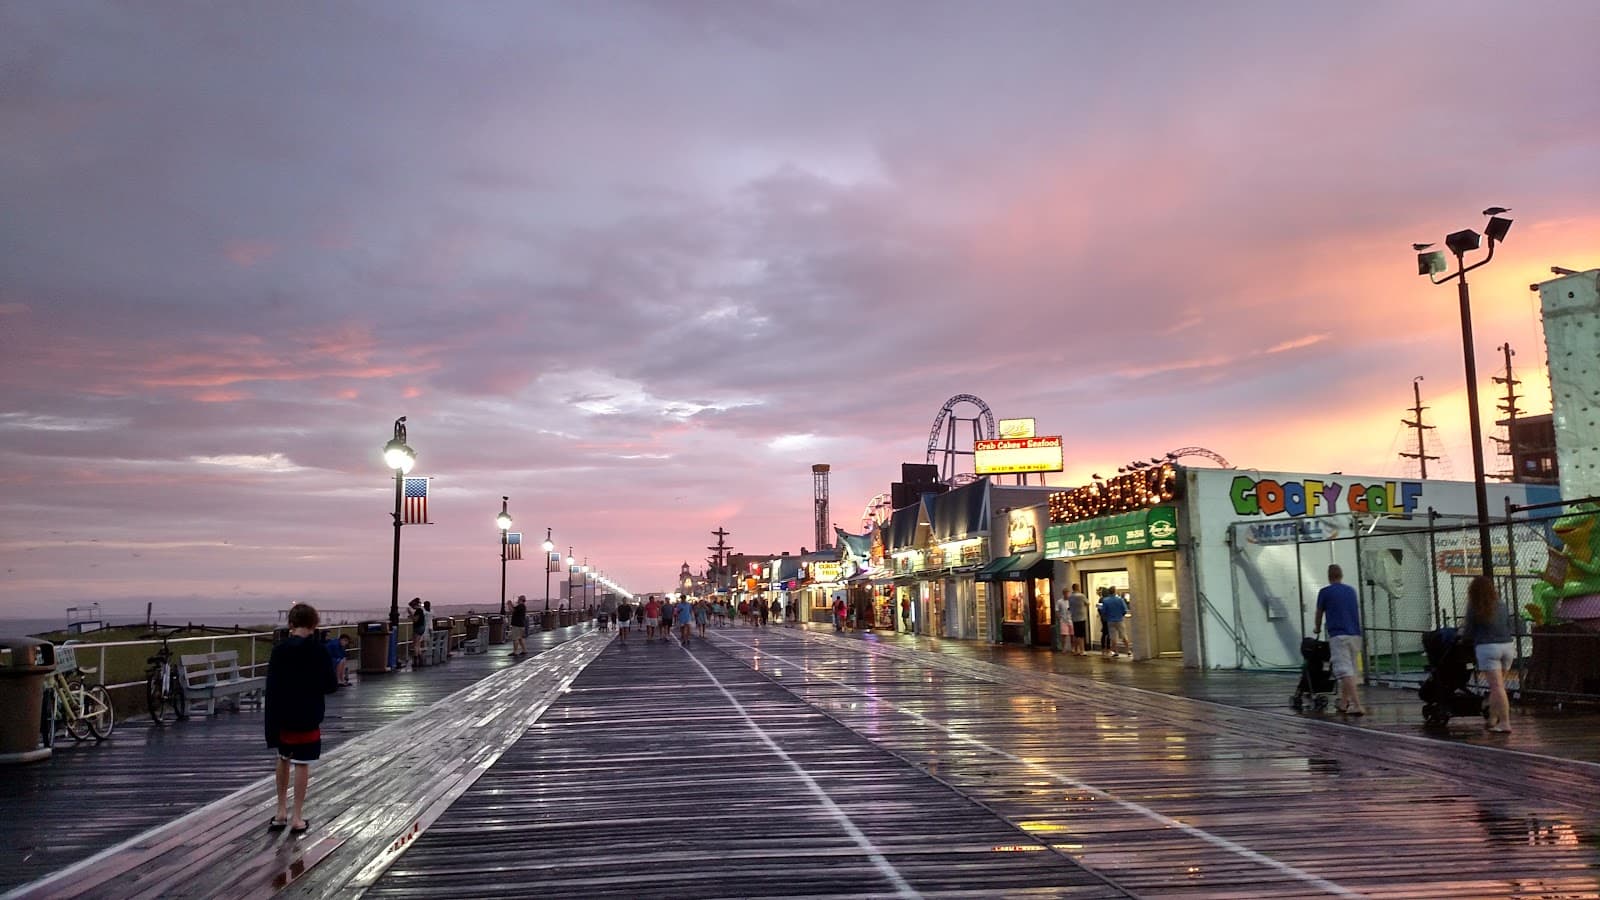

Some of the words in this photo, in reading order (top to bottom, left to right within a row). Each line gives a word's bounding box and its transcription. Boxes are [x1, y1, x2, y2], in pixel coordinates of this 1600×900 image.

[977, 442, 996, 450] Crab
[1027, 438, 1059, 448] Seafood
[1229, 475, 1343, 517] GOOFY
[1347, 481, 1422, 520] GOLF
